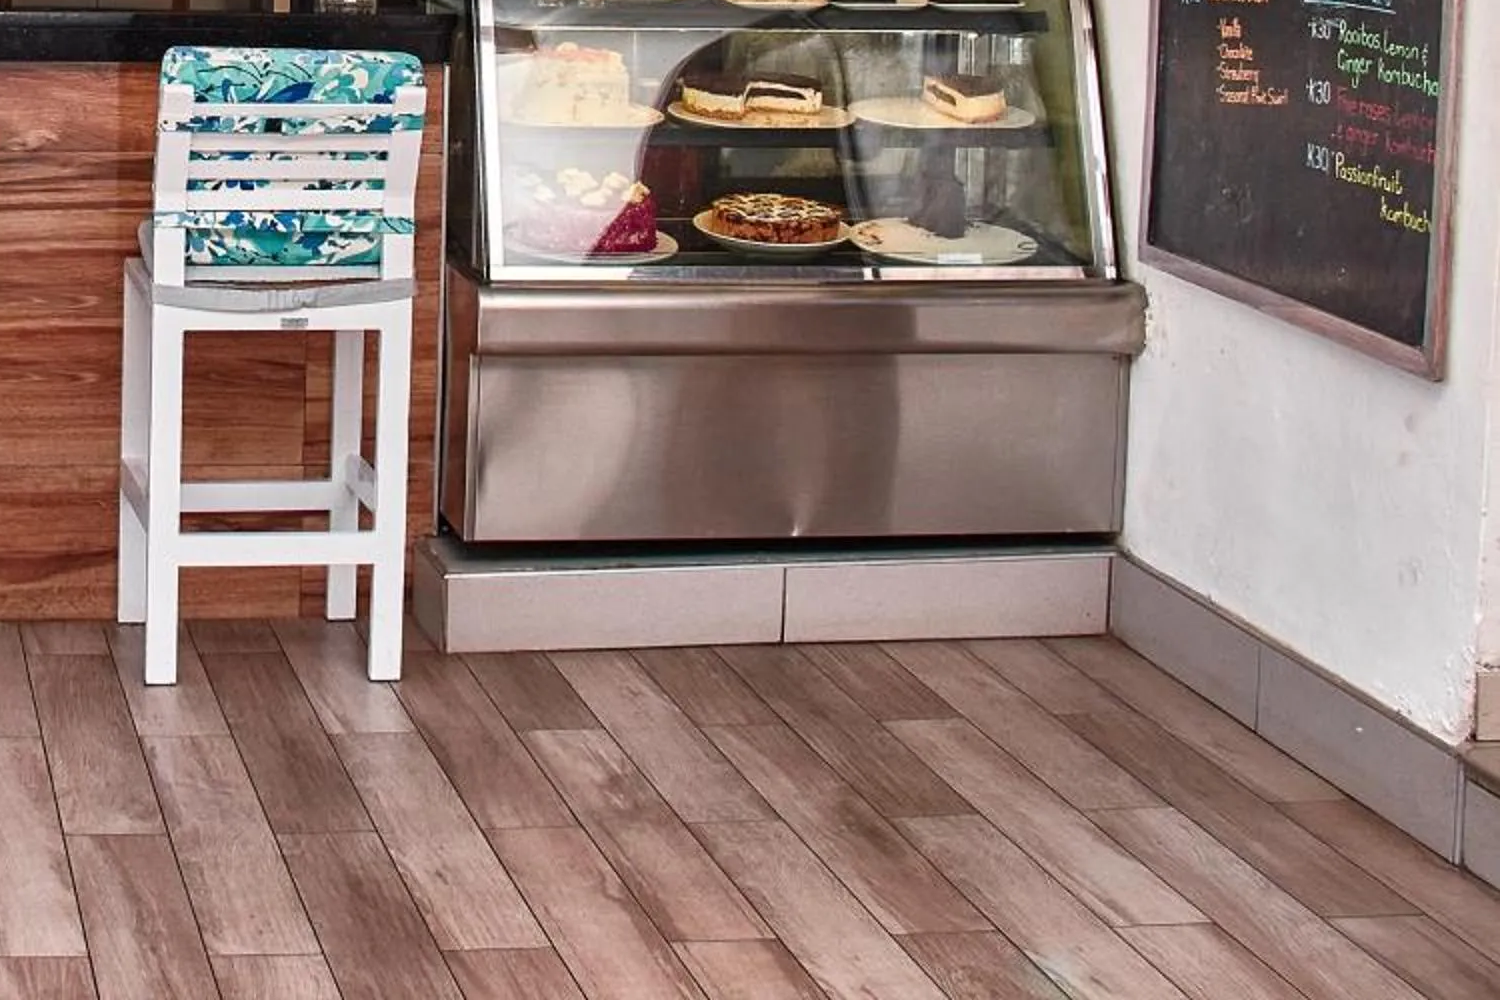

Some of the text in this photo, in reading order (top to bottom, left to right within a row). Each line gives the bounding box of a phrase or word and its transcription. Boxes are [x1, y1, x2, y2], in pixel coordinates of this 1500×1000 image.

[1383, 28, 1419, 61] Lemon
[1337, 47, 1373, 89] Ginger
[1307, 77, 1332, 105] K30
[1306, 141, 1403, 195] K30 Passionfruit
